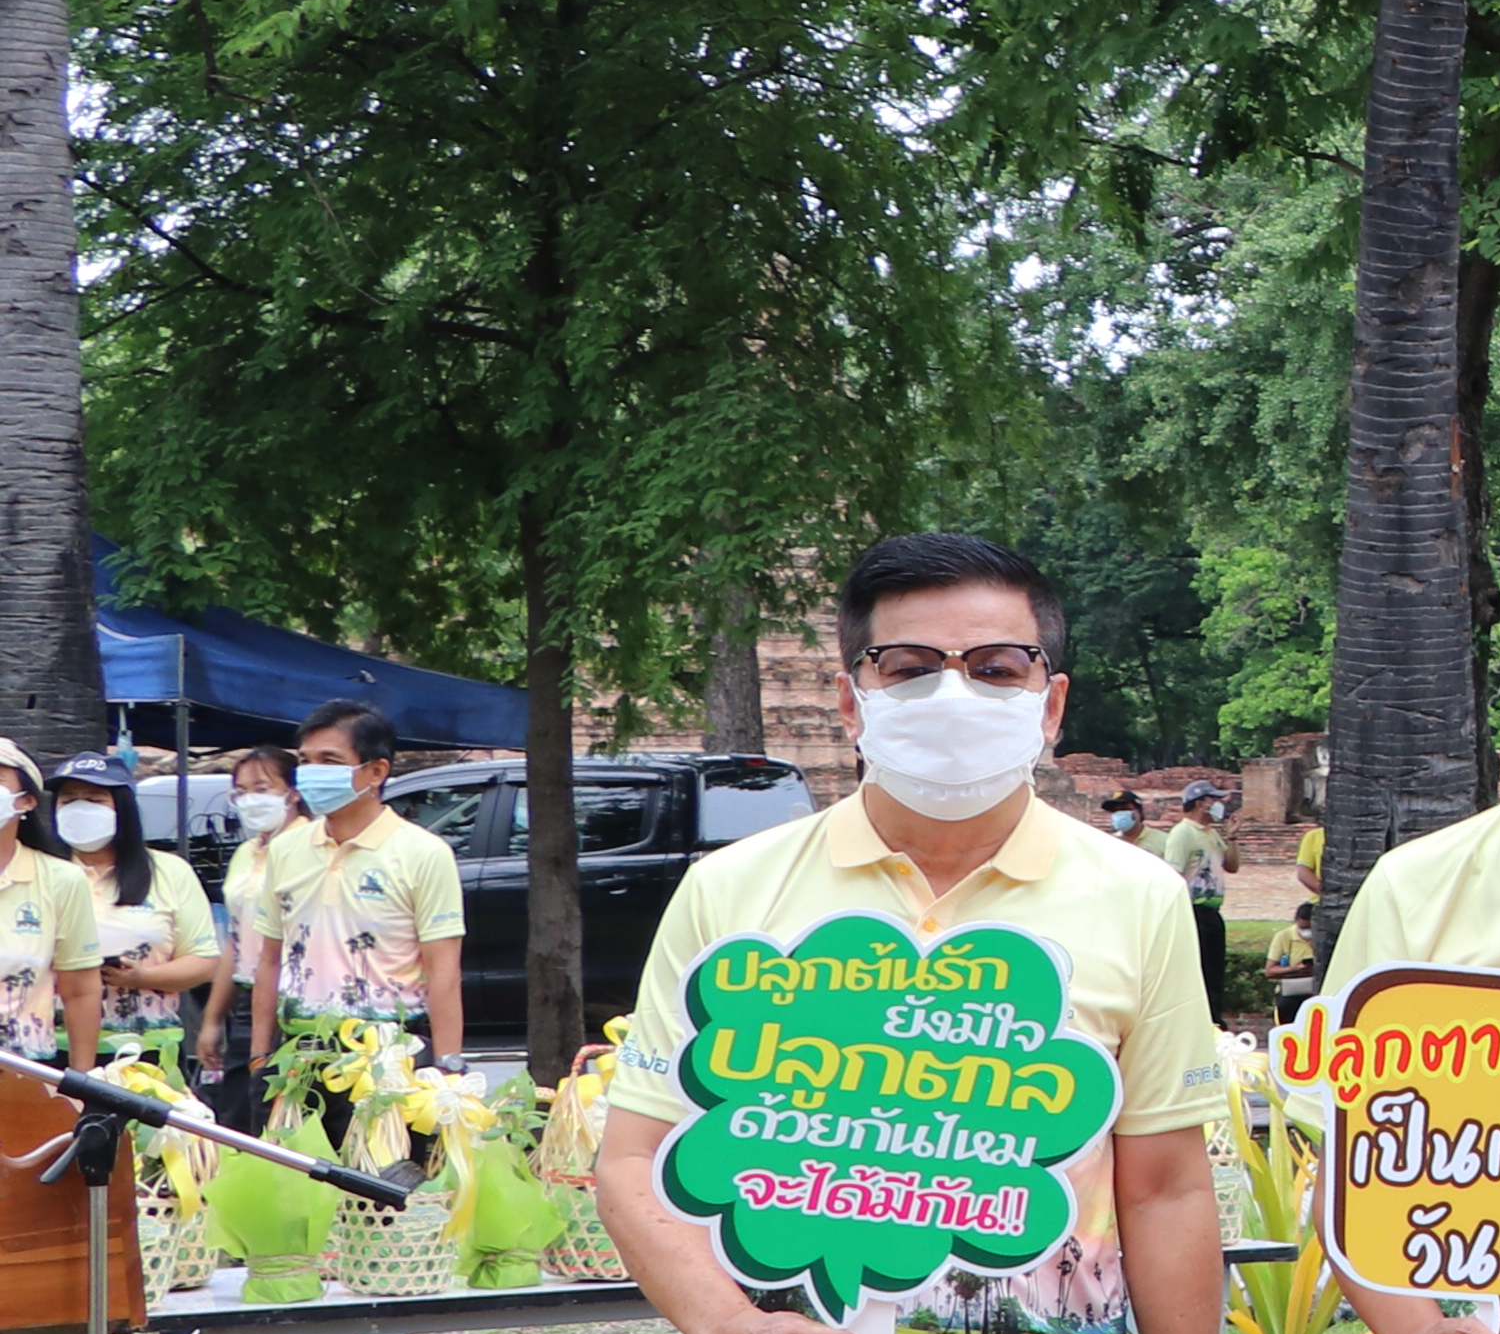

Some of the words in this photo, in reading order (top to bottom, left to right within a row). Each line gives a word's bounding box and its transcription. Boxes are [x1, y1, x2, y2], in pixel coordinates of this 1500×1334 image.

[715, 942, 1009, 1004] ปลูกต้นรัก
[882, 995, 1046, 1052] ยังมีใจ
[708, 1022, 1076, 1114] ปลูกตาล
[729, 1092, 1038, 1169] ด้วยกันไหม
[734, 1162, 1029, 1237] จะได้มีกัน!!
